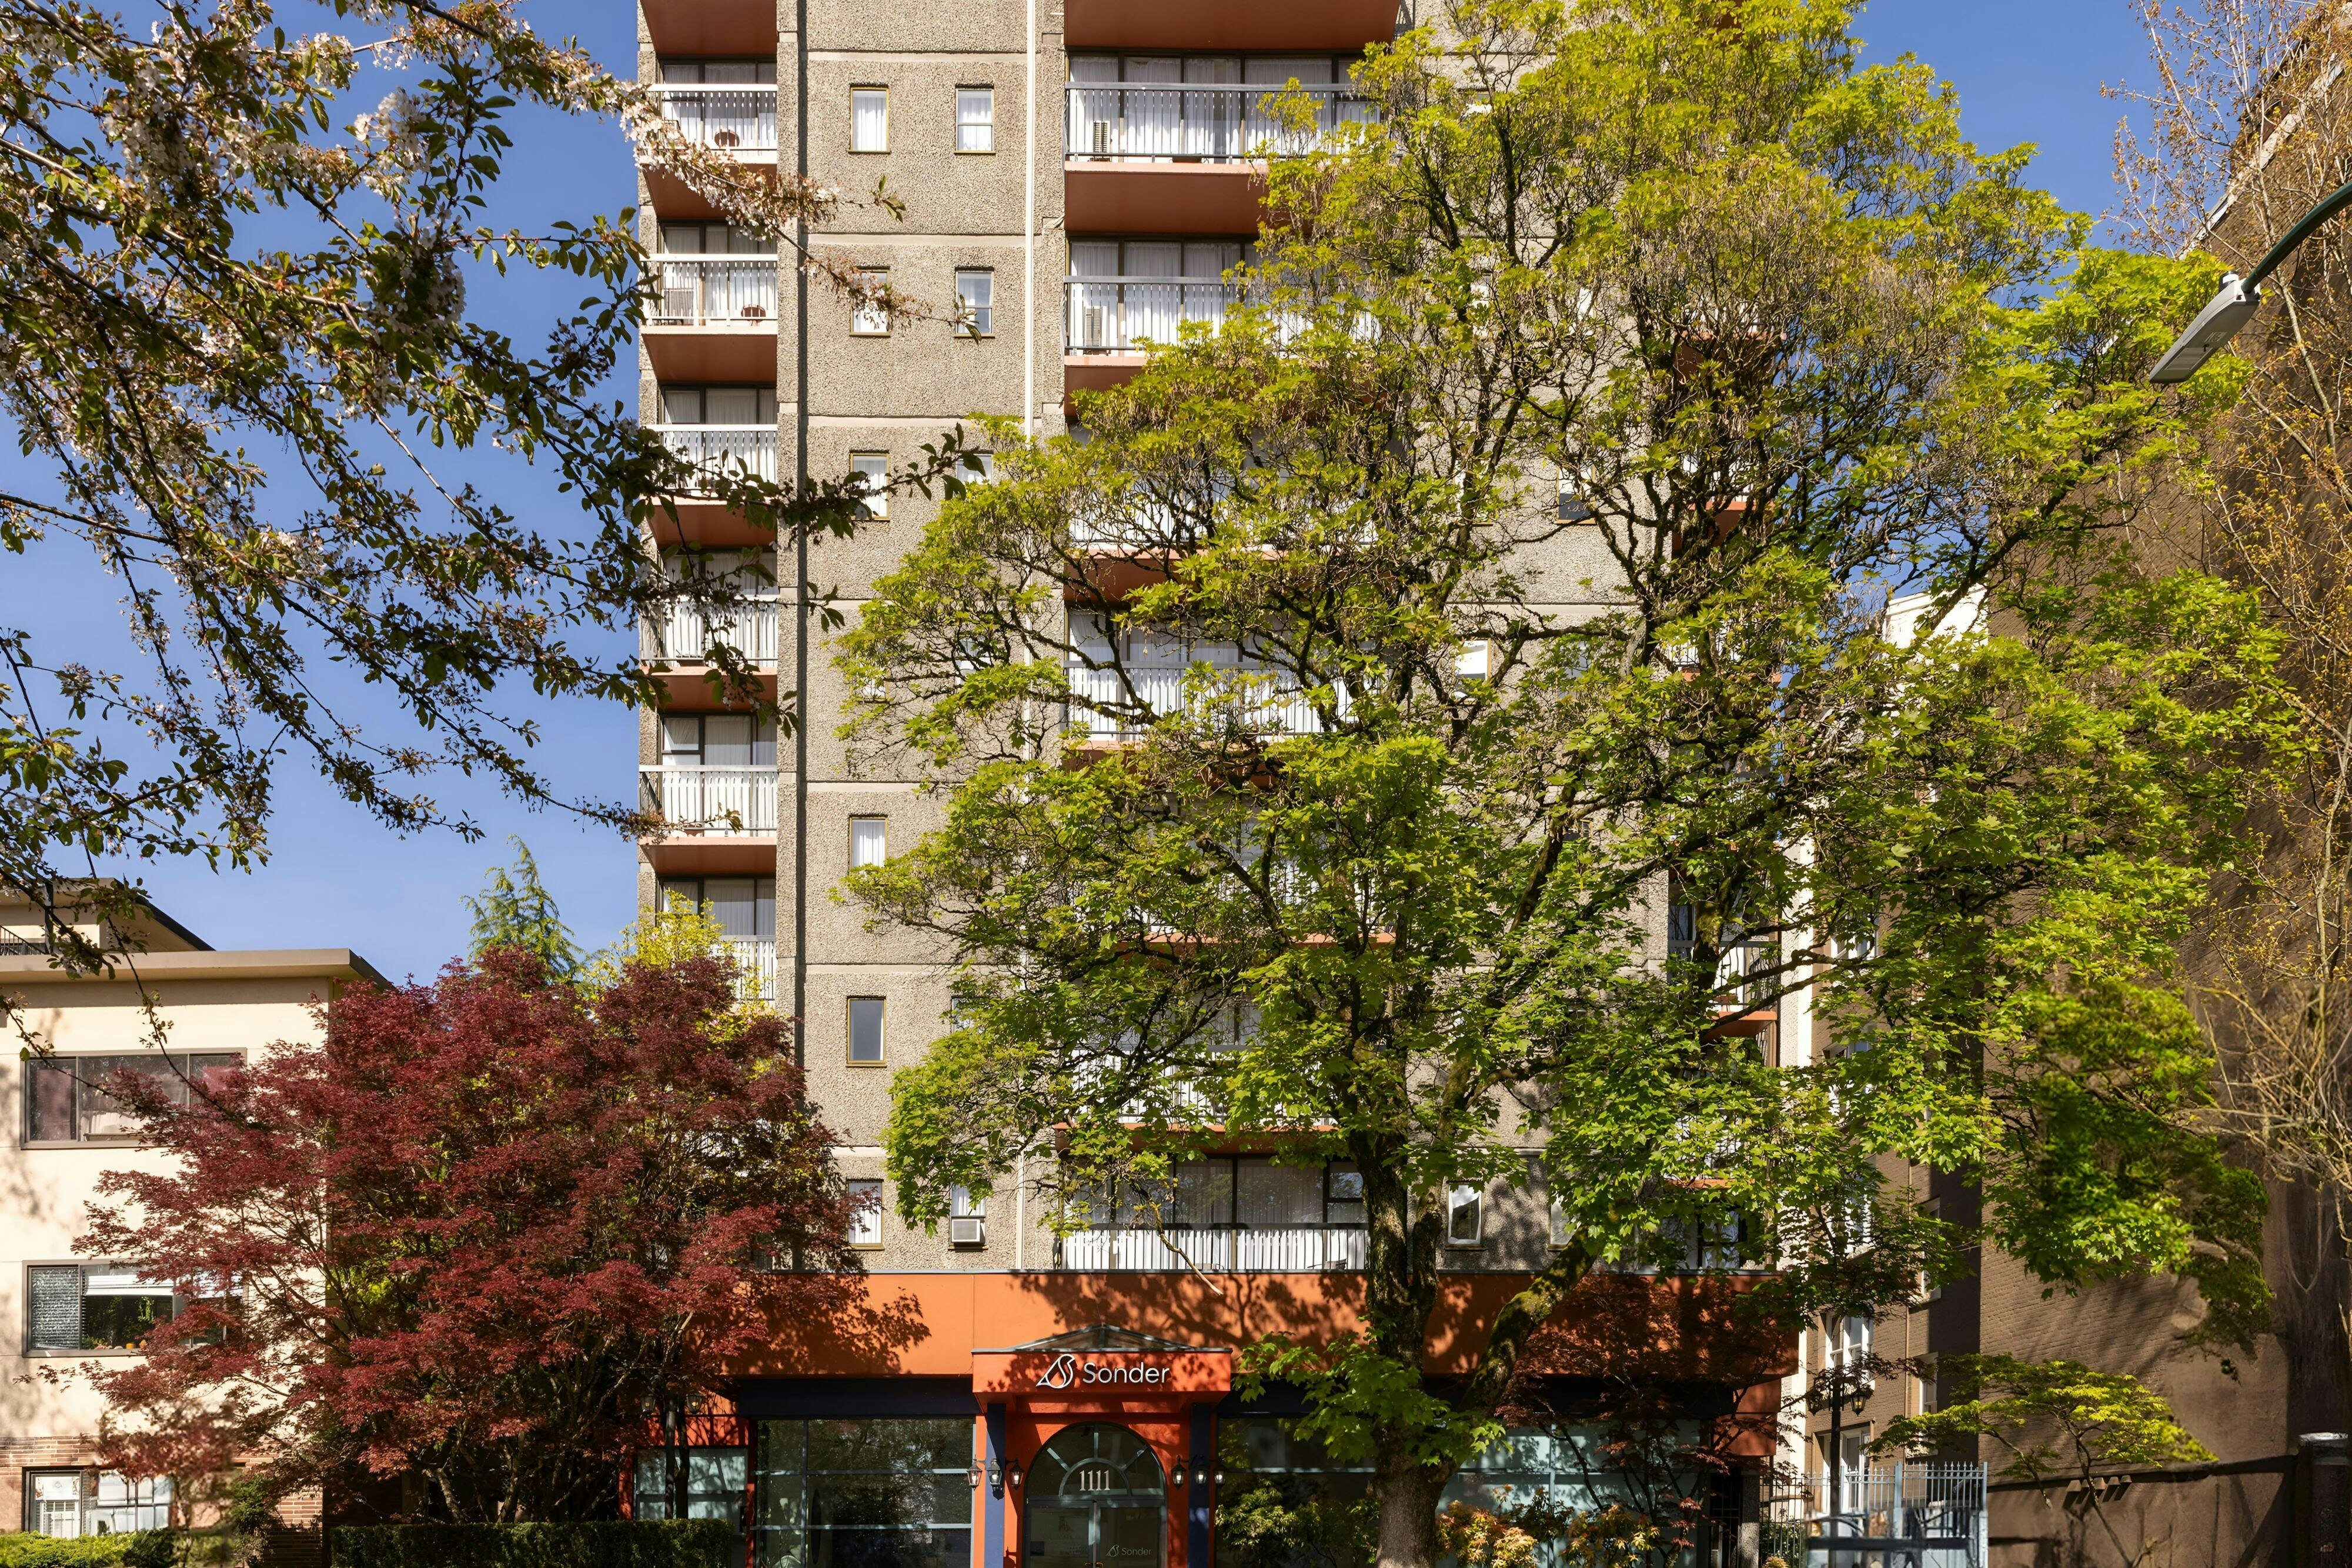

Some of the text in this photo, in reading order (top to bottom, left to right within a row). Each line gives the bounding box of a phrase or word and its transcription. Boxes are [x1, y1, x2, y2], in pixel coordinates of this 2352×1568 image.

[1083, 1362, 1170, 1383] Sonder
[1079, 1470, 1110, 1491] 1111
[1121, 1547, 1151, 1556] Sonder
